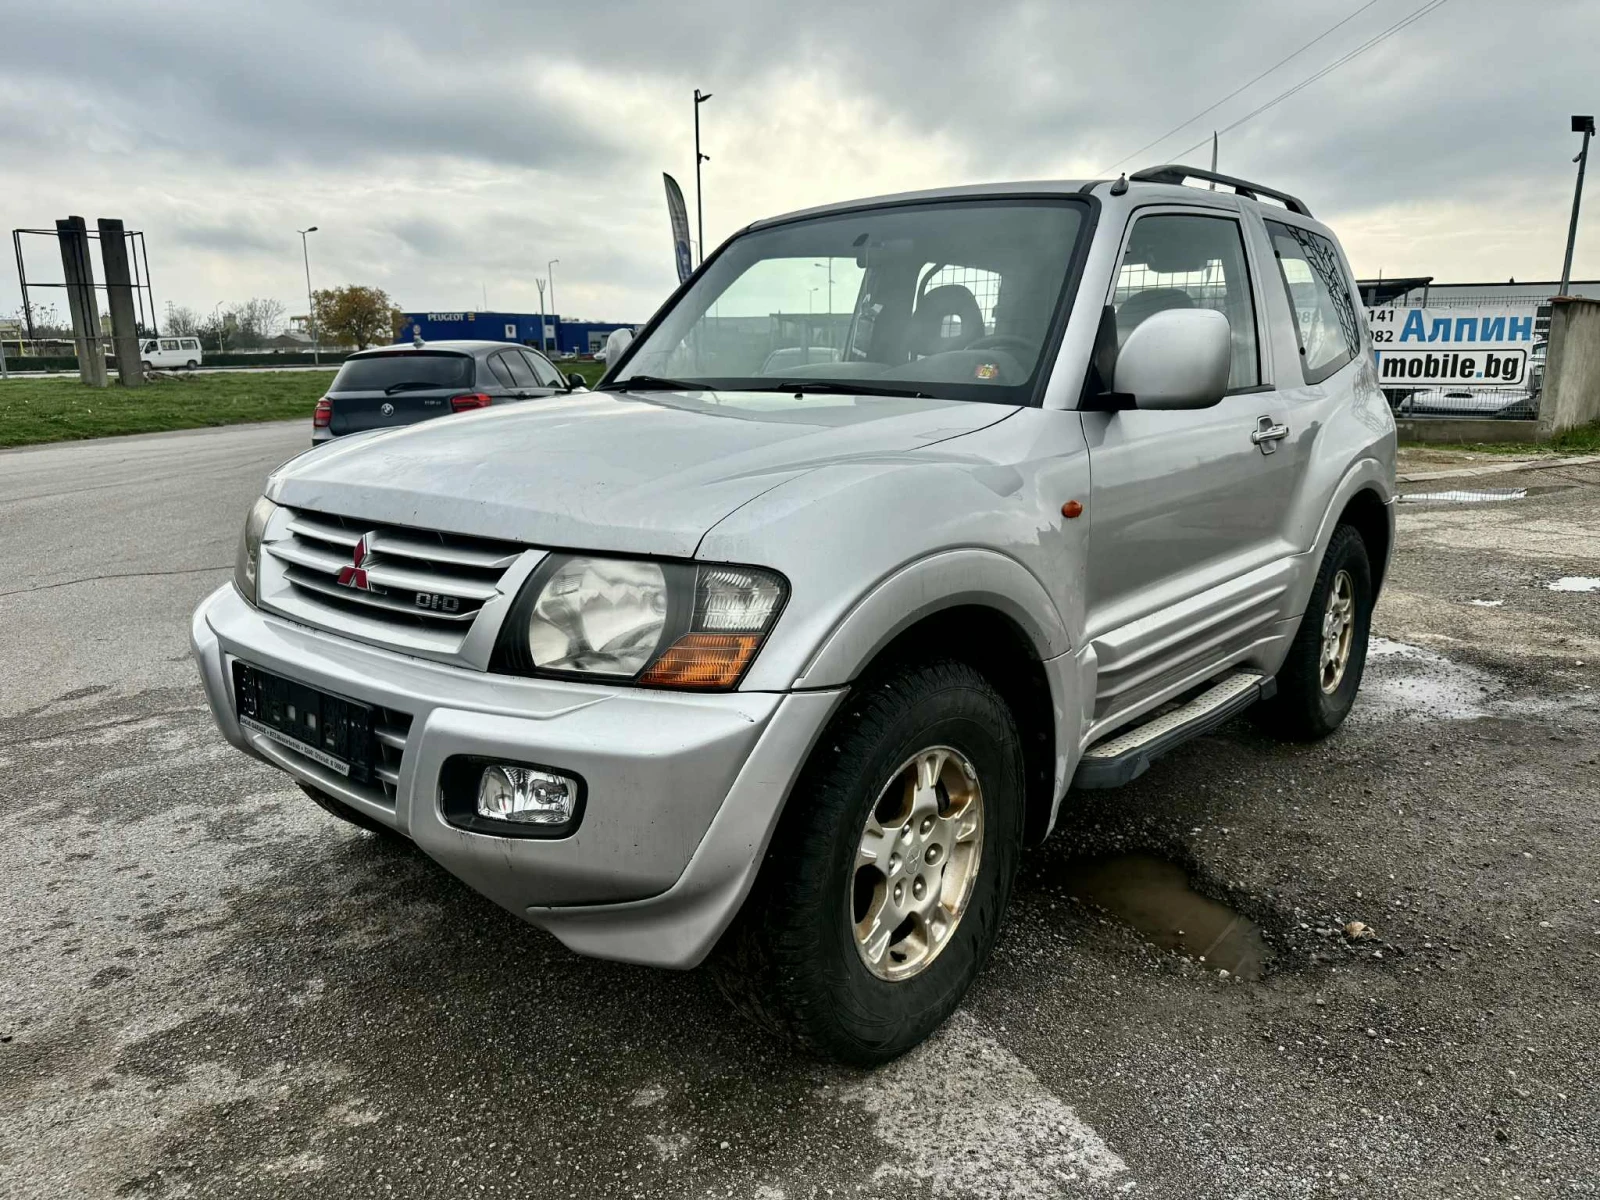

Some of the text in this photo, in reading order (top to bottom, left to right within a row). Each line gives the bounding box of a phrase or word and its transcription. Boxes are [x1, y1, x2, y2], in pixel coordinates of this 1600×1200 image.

[427, 313, 464, 321] PEUGEOT
[1368, 309, 1394, 323] 141
[1399, 309, 1533, 343] Алпин
[1382, 353, 1520, 381] mobile.bg
